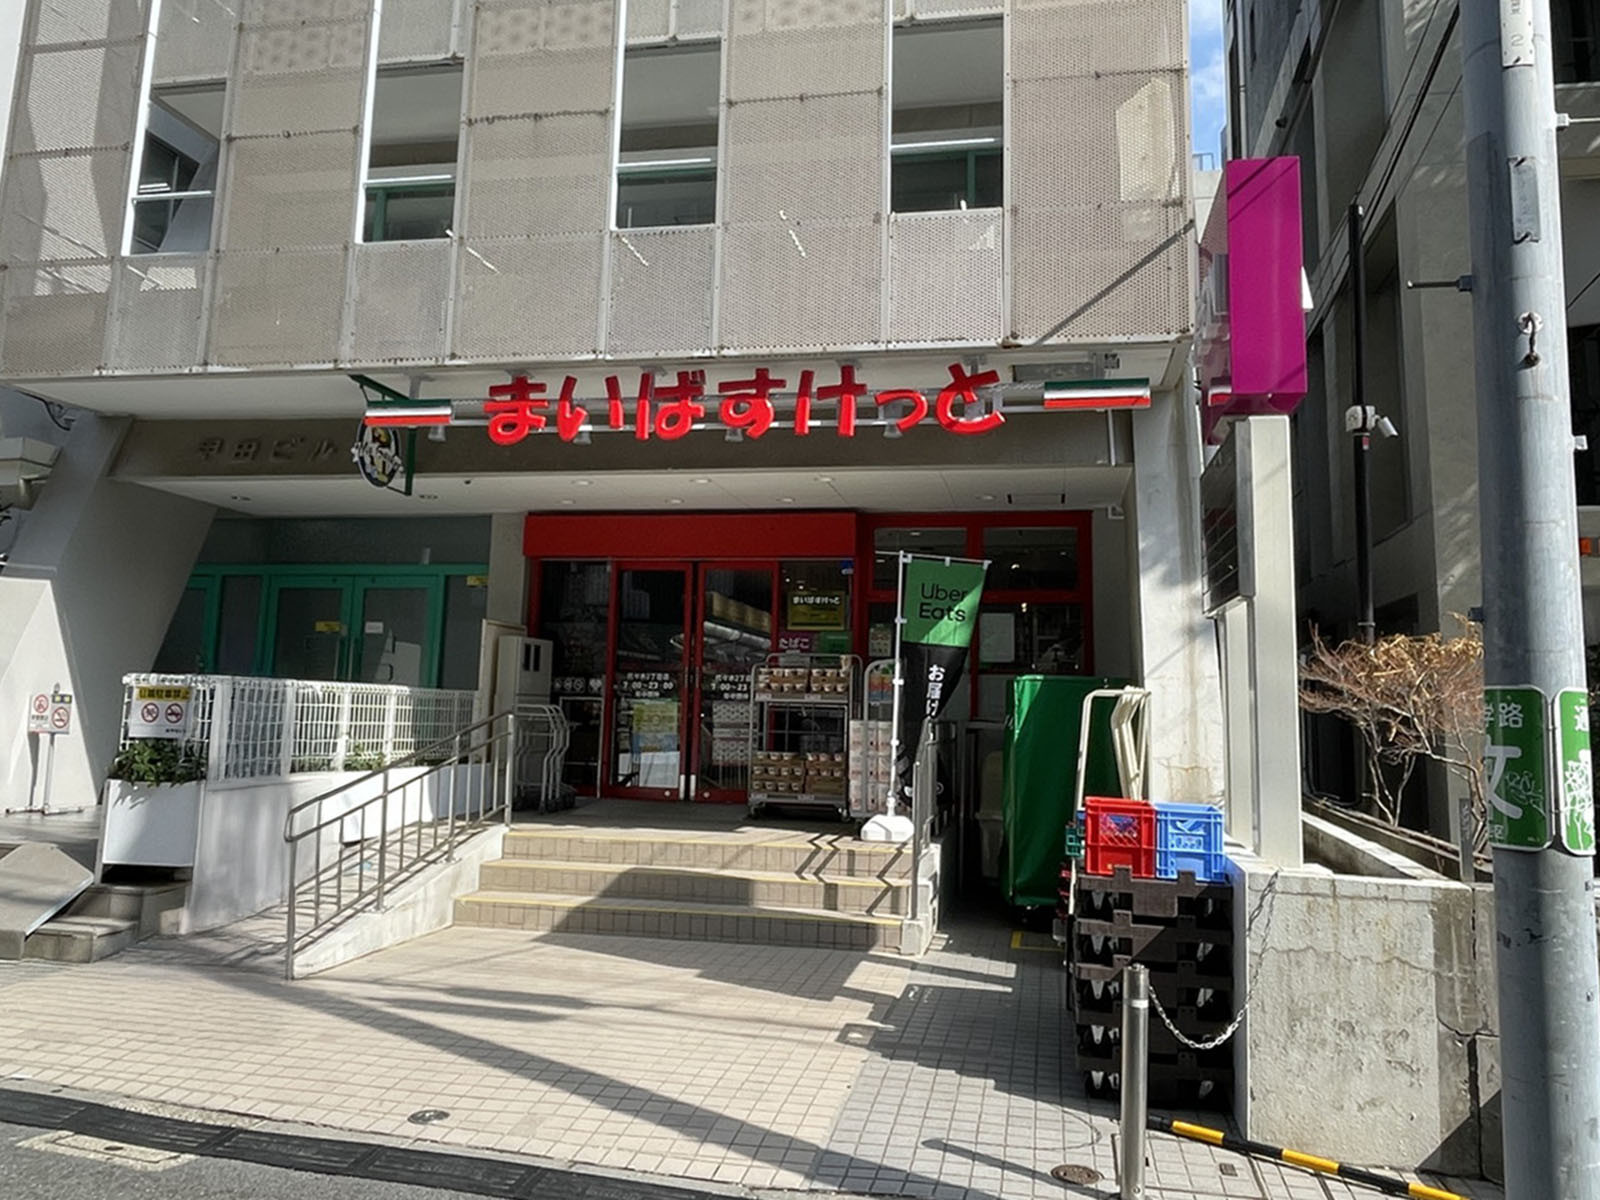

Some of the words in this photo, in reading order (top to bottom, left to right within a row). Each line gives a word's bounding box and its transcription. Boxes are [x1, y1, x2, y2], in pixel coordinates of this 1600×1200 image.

[483, 363, 1005, 443] まいばすけっと
[921, 583, 968, 601] Uber
[919, 602, 966, 622] Eats
[780, 637, 809, 649] たばこ
[926, 664, 946, 716] お届け
